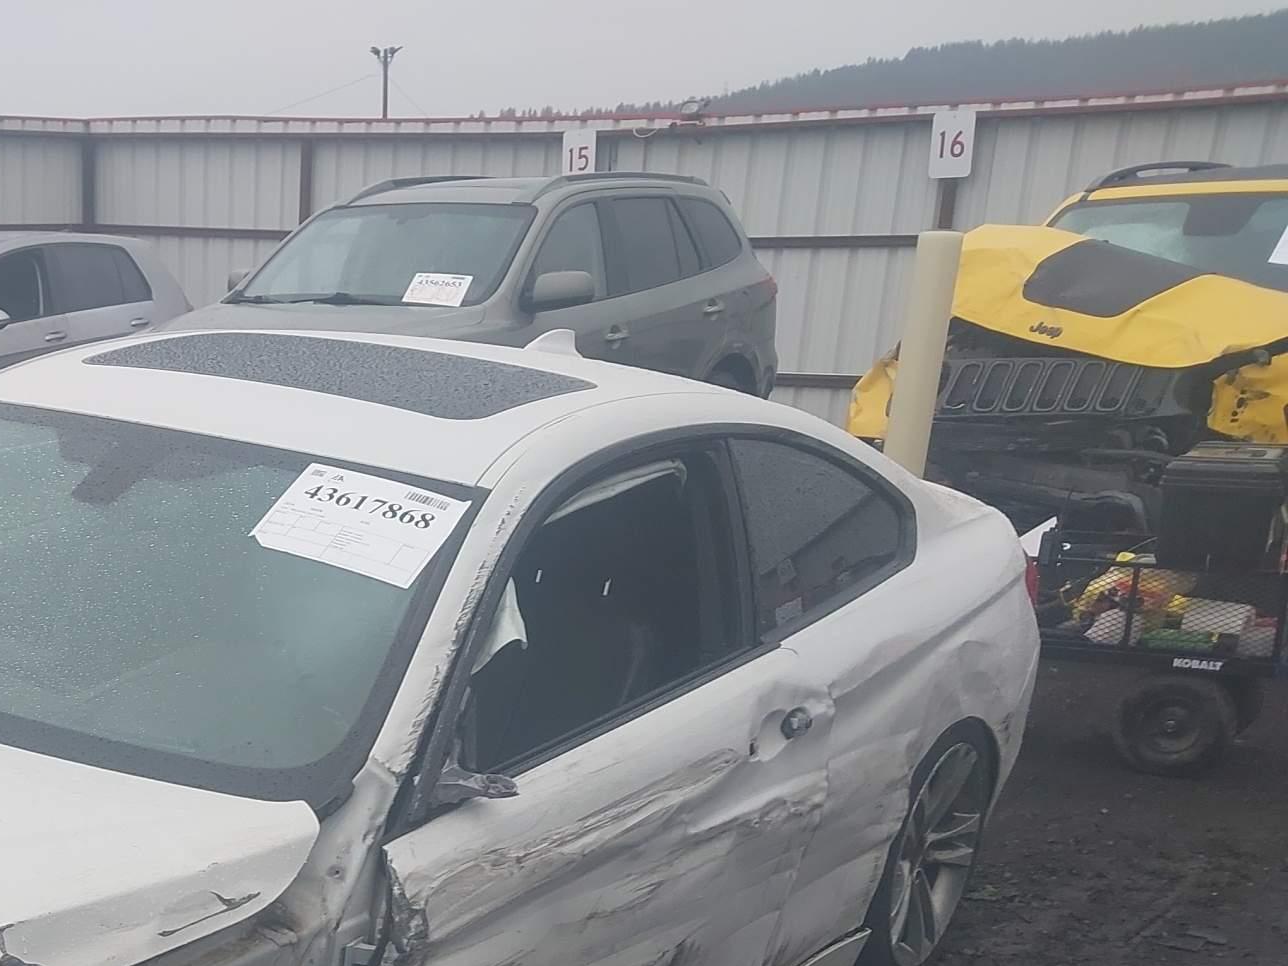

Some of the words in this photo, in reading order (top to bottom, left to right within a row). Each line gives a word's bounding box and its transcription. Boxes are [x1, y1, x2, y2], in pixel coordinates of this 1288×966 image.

[939, 130, 965, 159] 16
[568, 146, 589, 172] 15
[1029, 321, 1063, 340] Jeep
[304, 484, 436, 530] 43617868
[1172, 658, 1224, 671] KOBALT
